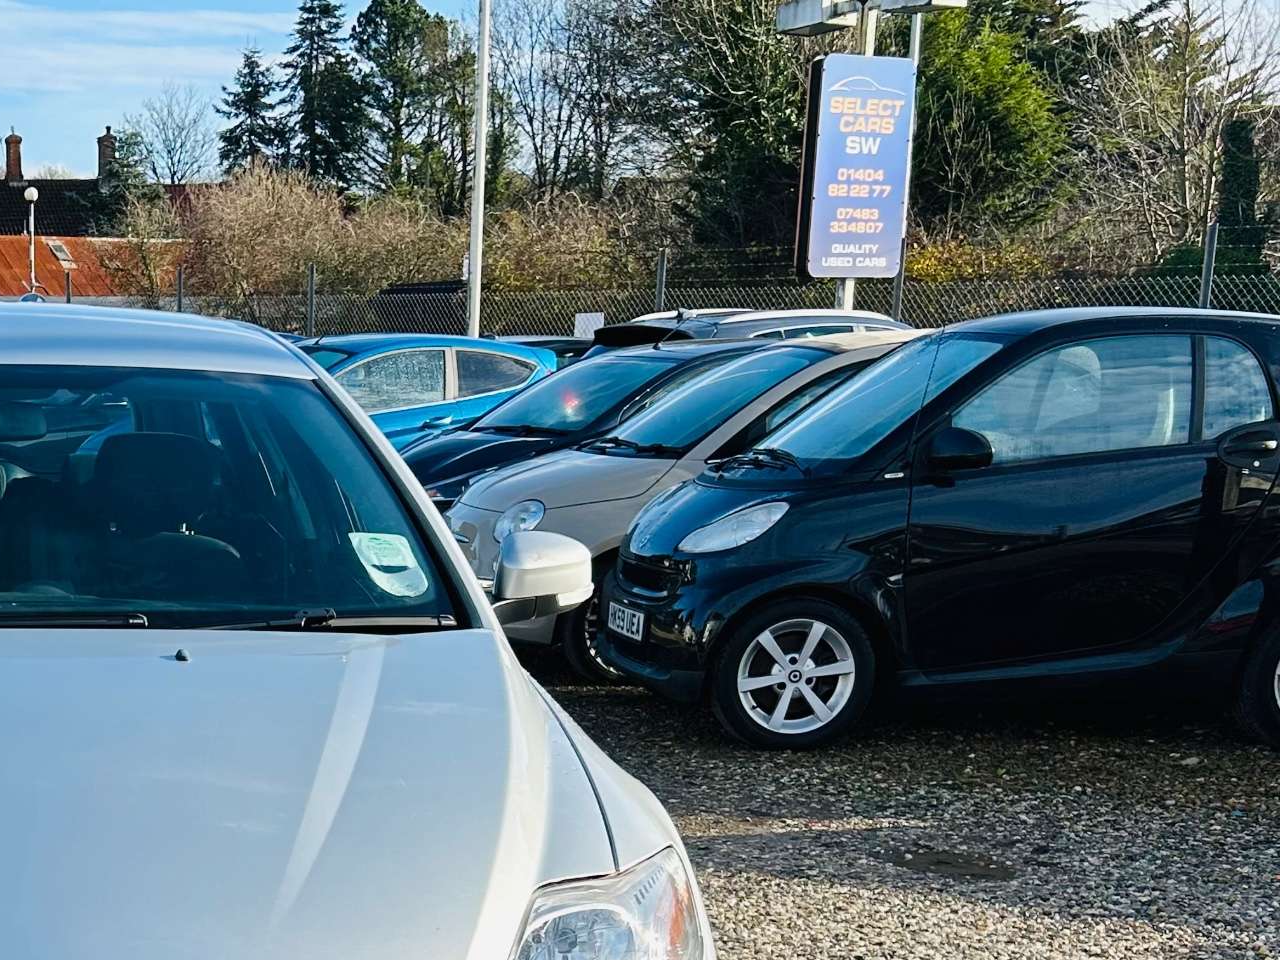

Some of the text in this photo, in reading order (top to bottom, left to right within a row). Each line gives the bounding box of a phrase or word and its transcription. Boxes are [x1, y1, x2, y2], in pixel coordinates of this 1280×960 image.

[830, 96, 905, 116] SELECT
[840, 115, 895, 134] CARS
[846, 136, 881, 154] SW
[837, 167, 885, 182] 01404
[828, 184, 892, 198] 82 22 77
[831, 244, 880, 254] QUALITY
[821, 257, 887, 267] USED CARS
